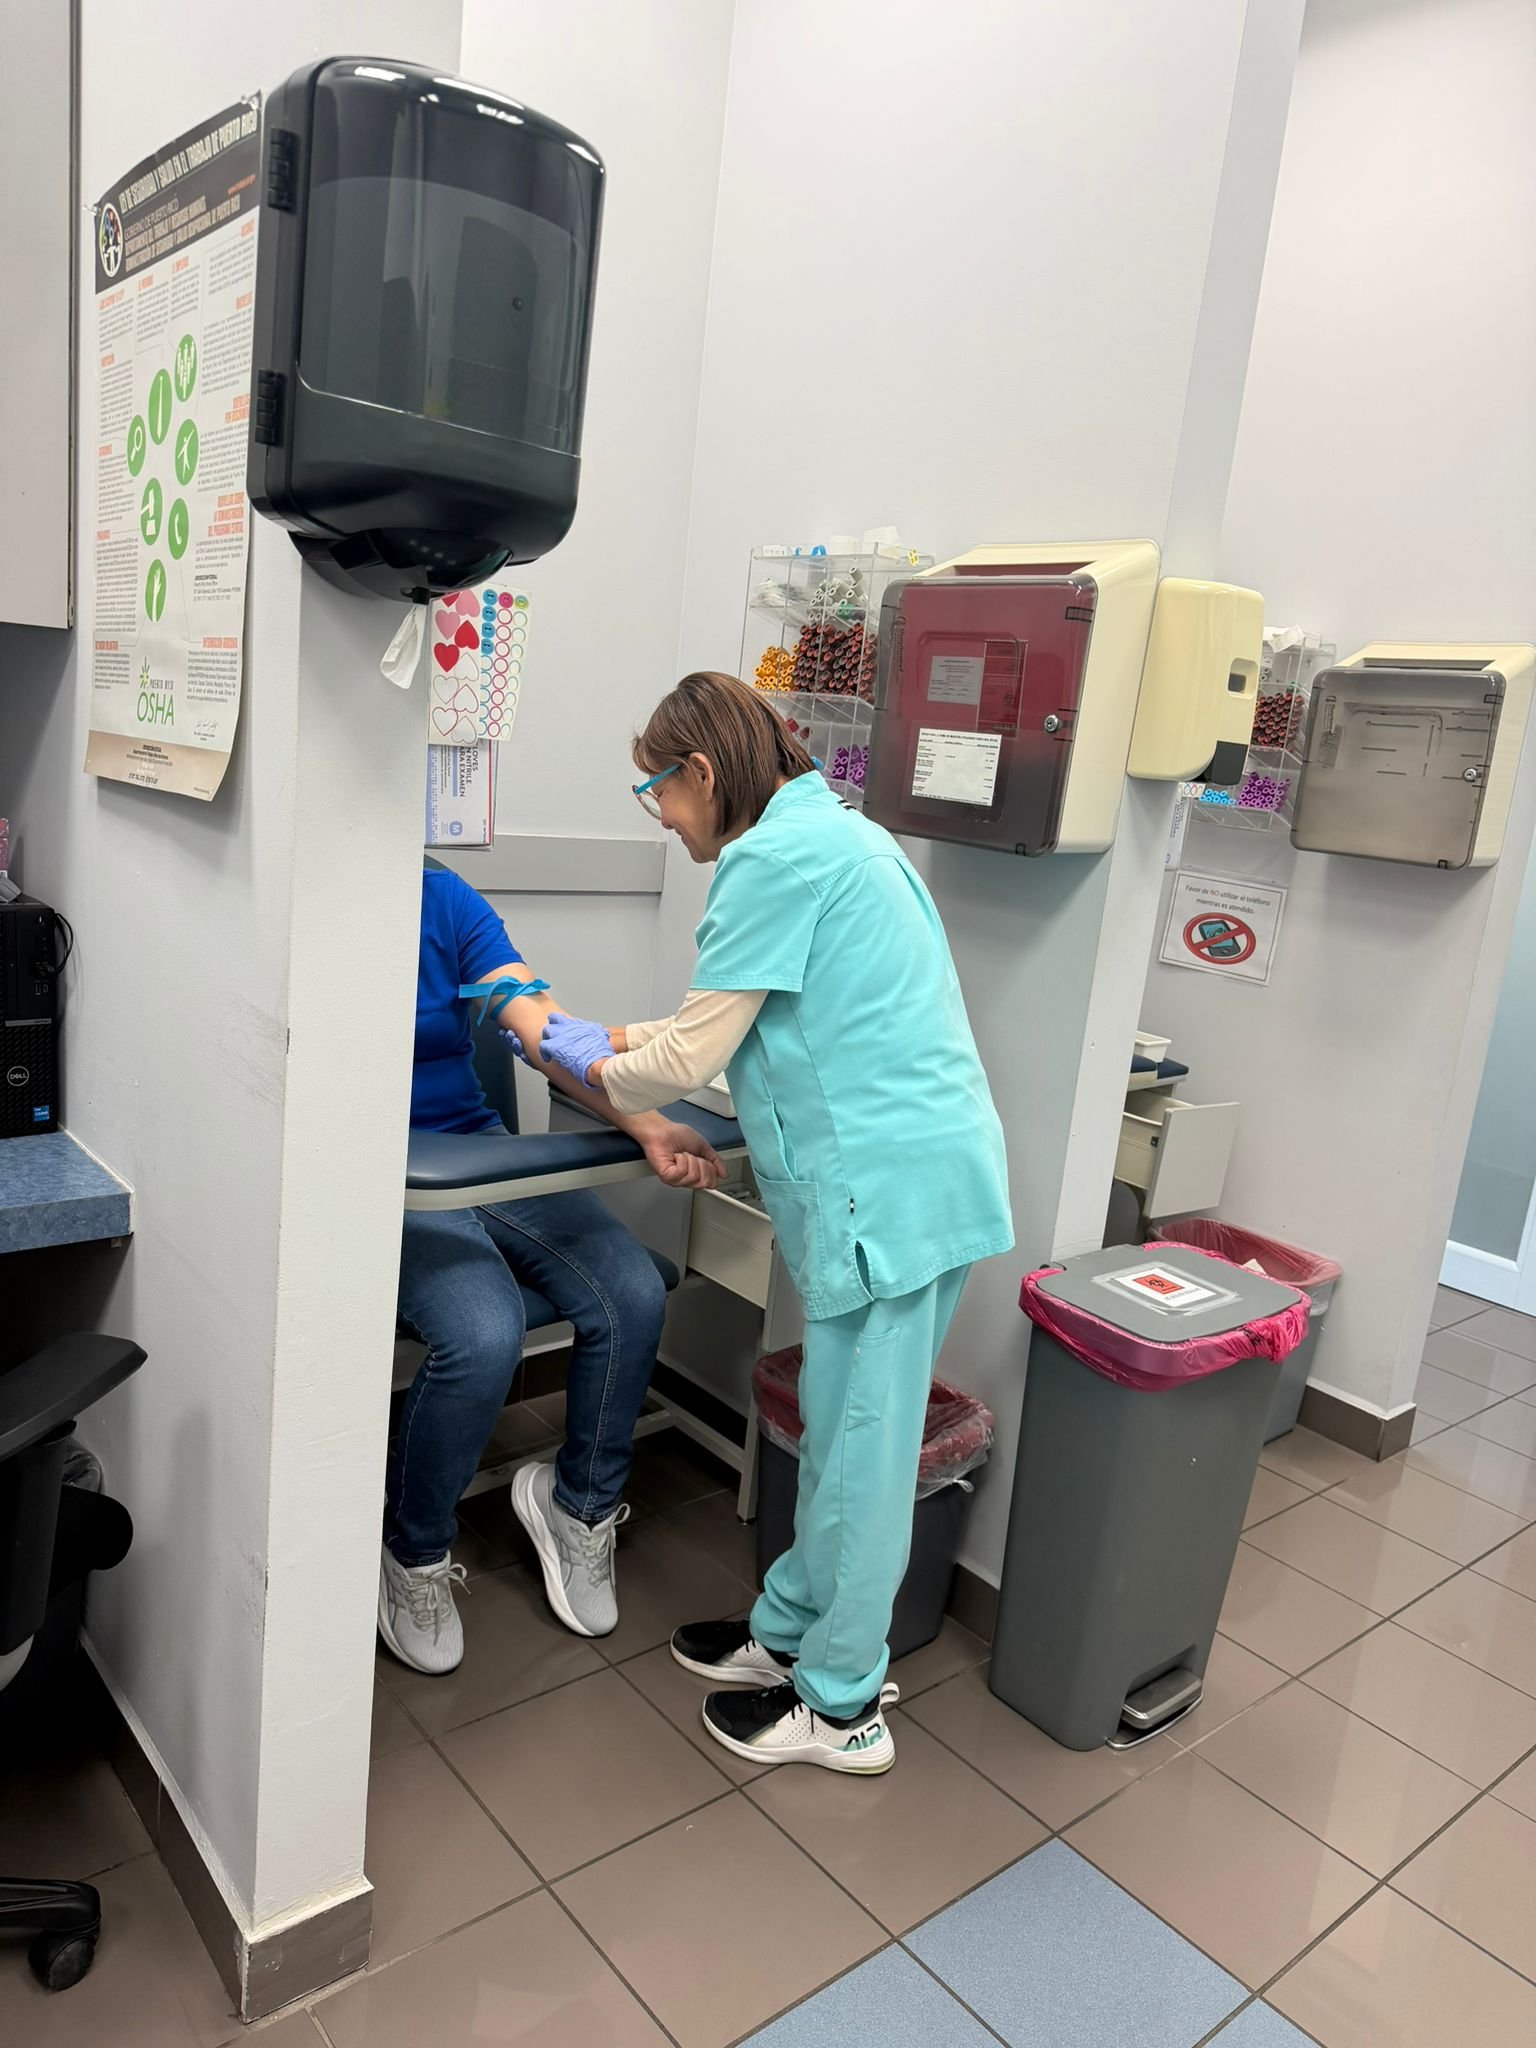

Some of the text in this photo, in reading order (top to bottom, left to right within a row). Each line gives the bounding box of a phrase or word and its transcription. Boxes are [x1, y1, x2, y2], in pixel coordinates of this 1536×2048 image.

[219, 117, 241, 150] PUERTO
[241, 111, 258, 136] RICO
[137, 692, 175, 726] OSHA
[1185, 884, 1201, 893] Favor
[1220, 891, 1239, 900] utilizar
[1196, 898, 1220, 907] mientras
[842, 1723, 882, 1751] AIR
